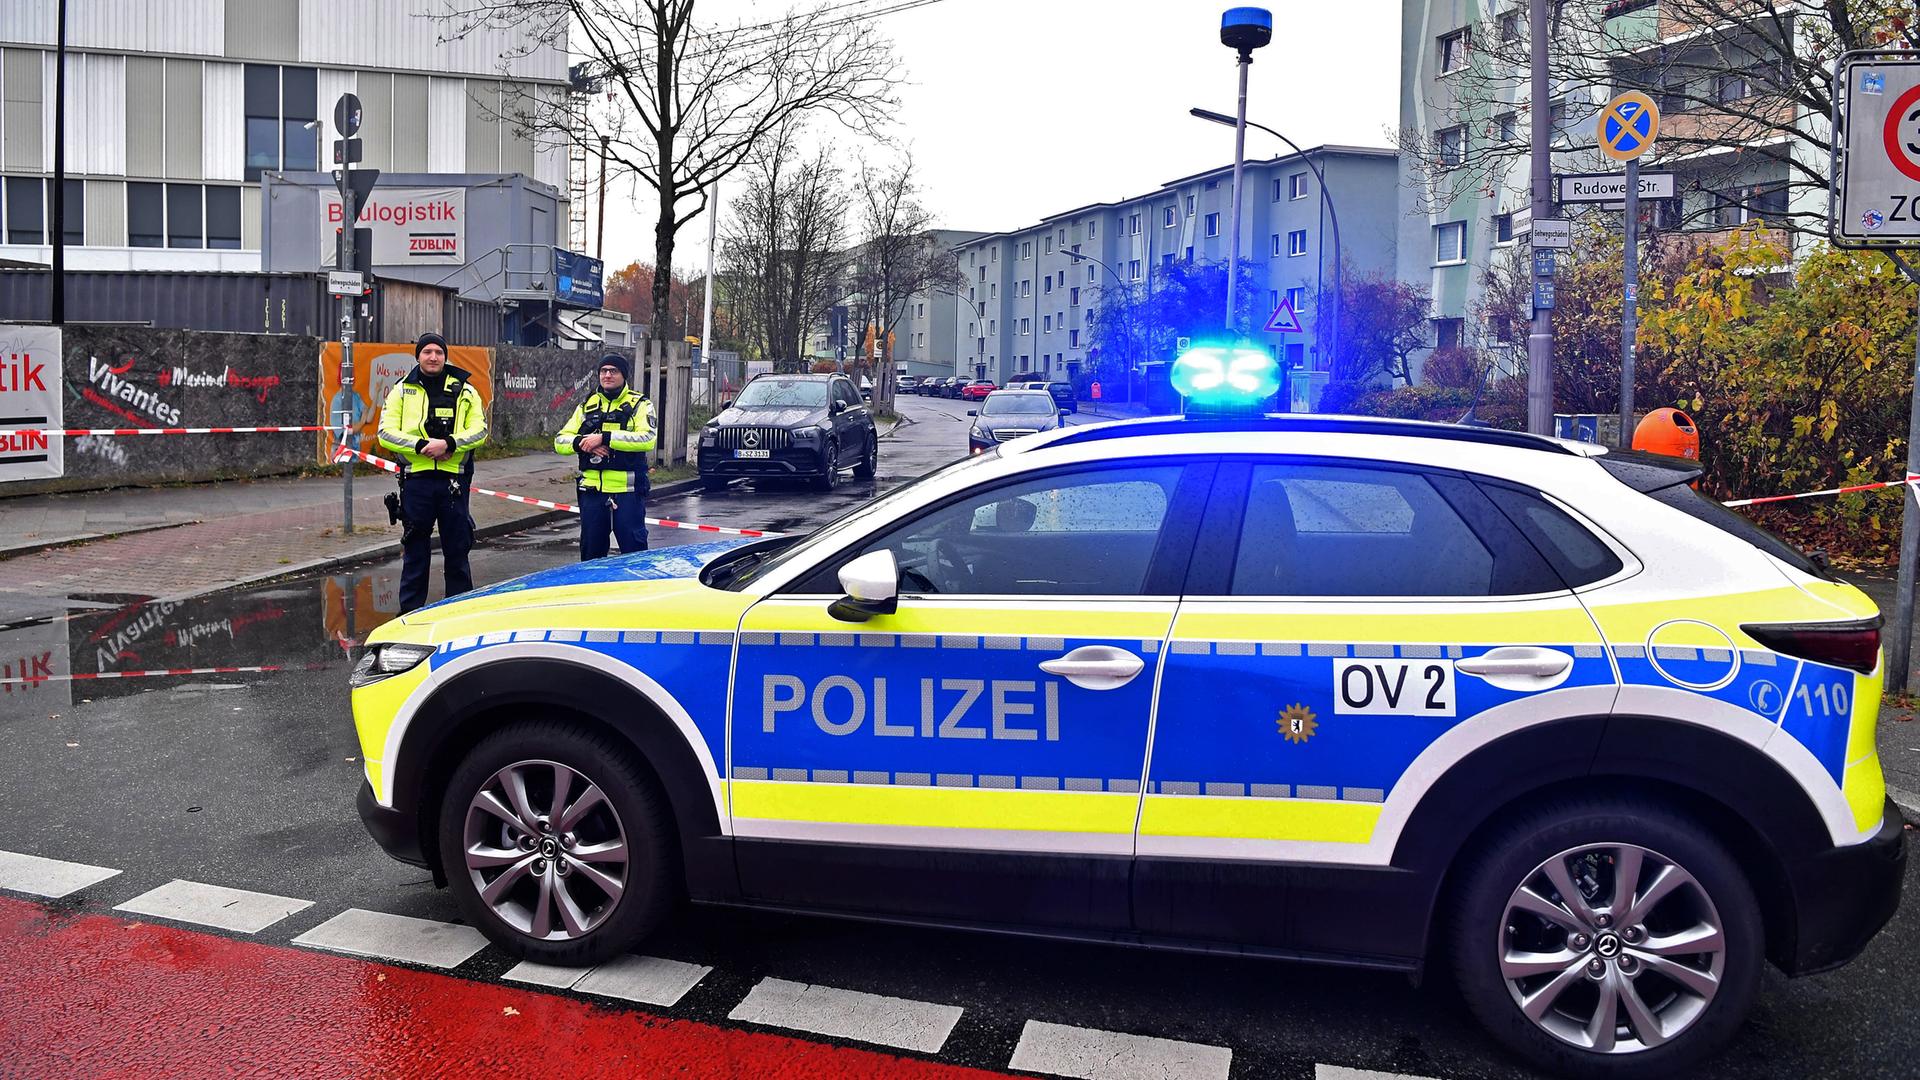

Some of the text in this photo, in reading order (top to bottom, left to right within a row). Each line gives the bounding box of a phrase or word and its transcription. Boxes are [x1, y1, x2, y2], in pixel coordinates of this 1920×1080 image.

[1573, 179, 1660, 195] Rudowe Str.
[328, 201, 456, 226] Bulogistik
[409, 239, 456, 251] ZÜBLIN
[88, 356, 181, 426] Vivantes
[503, 371, 538, 389] Vivantes
[1341, 664, 1446, 710] OV 2
[1796, 682, 1849, 718] 110
[763, 674, 1060, 742] POLIZEI
